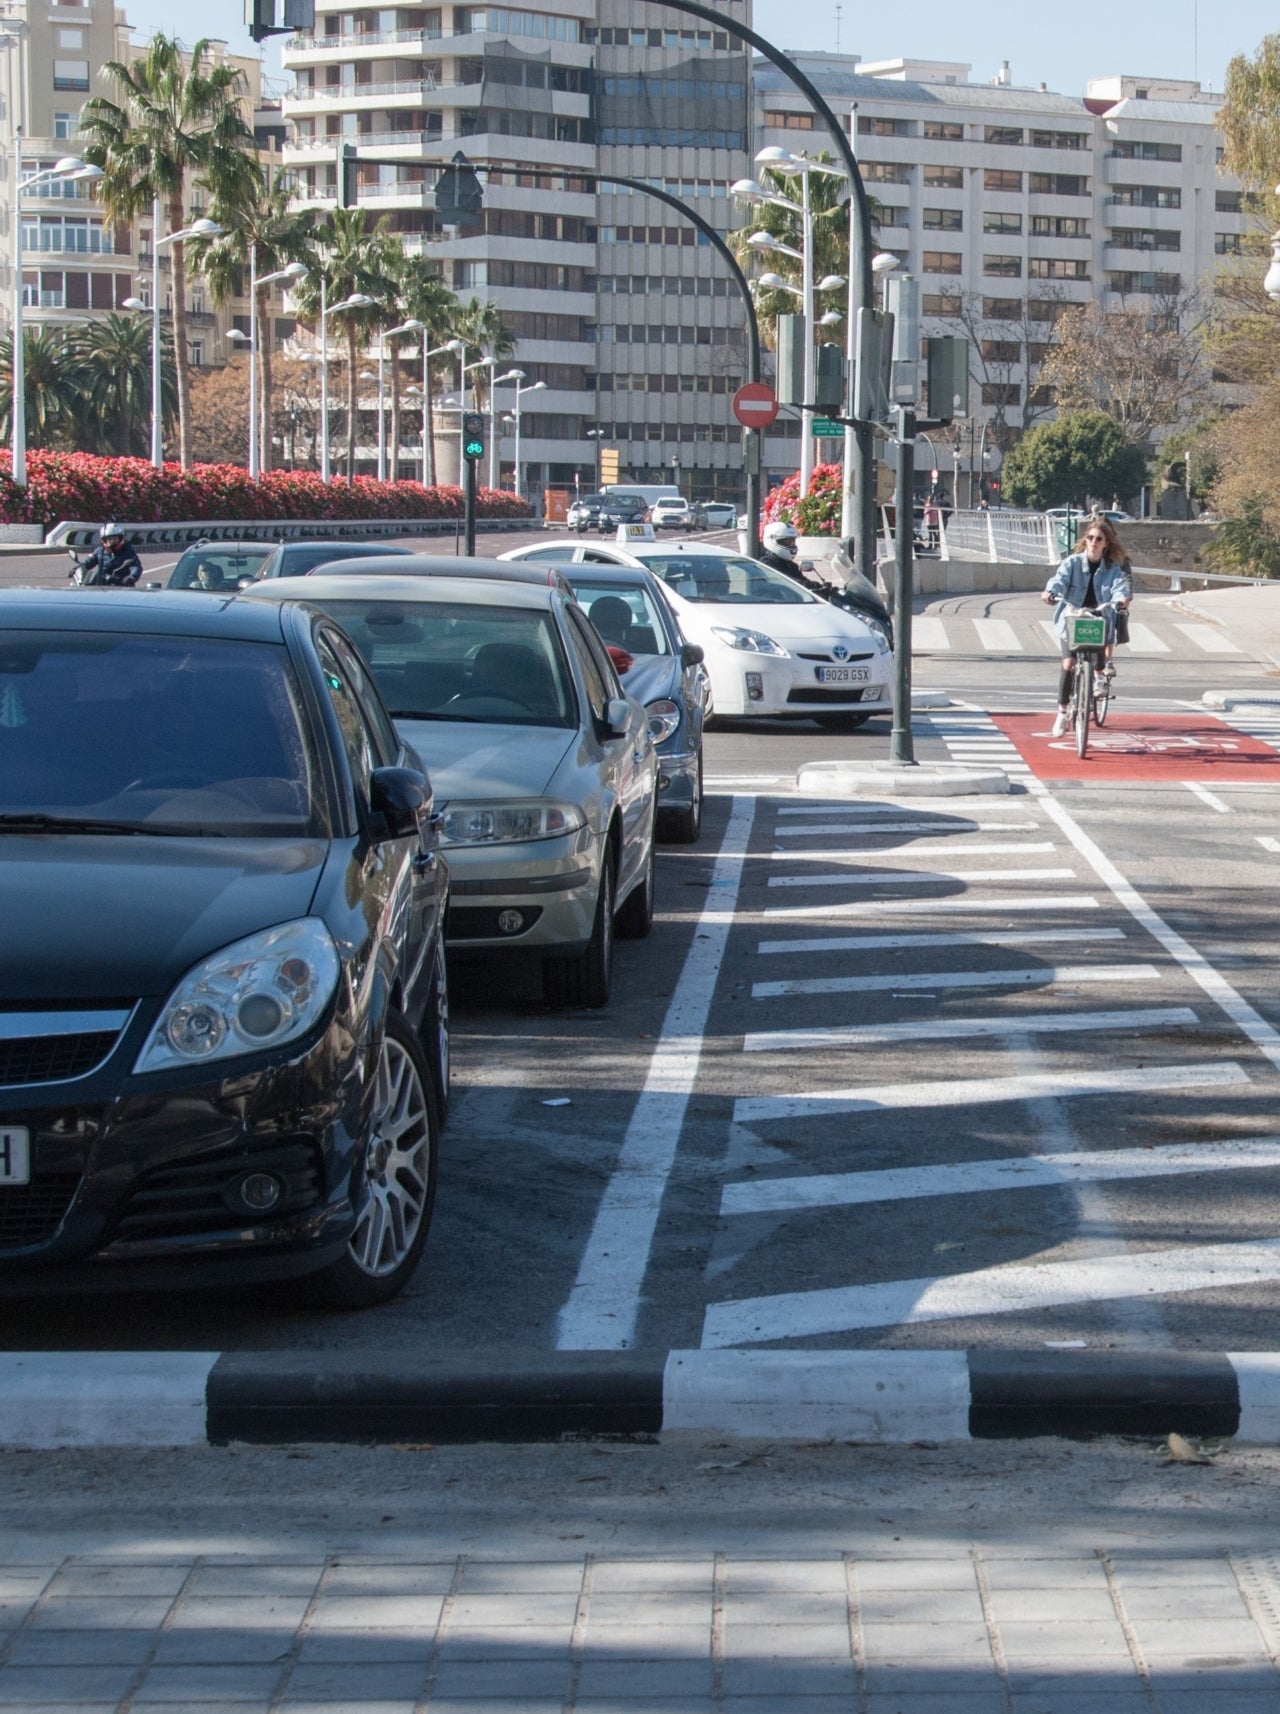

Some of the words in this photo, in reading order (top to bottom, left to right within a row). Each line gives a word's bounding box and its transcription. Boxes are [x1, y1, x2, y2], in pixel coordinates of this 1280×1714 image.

[825, 669, 849, 681] 9029
[851, 669, 869, 681] GSX
[864, 688, 879, 700] SP
